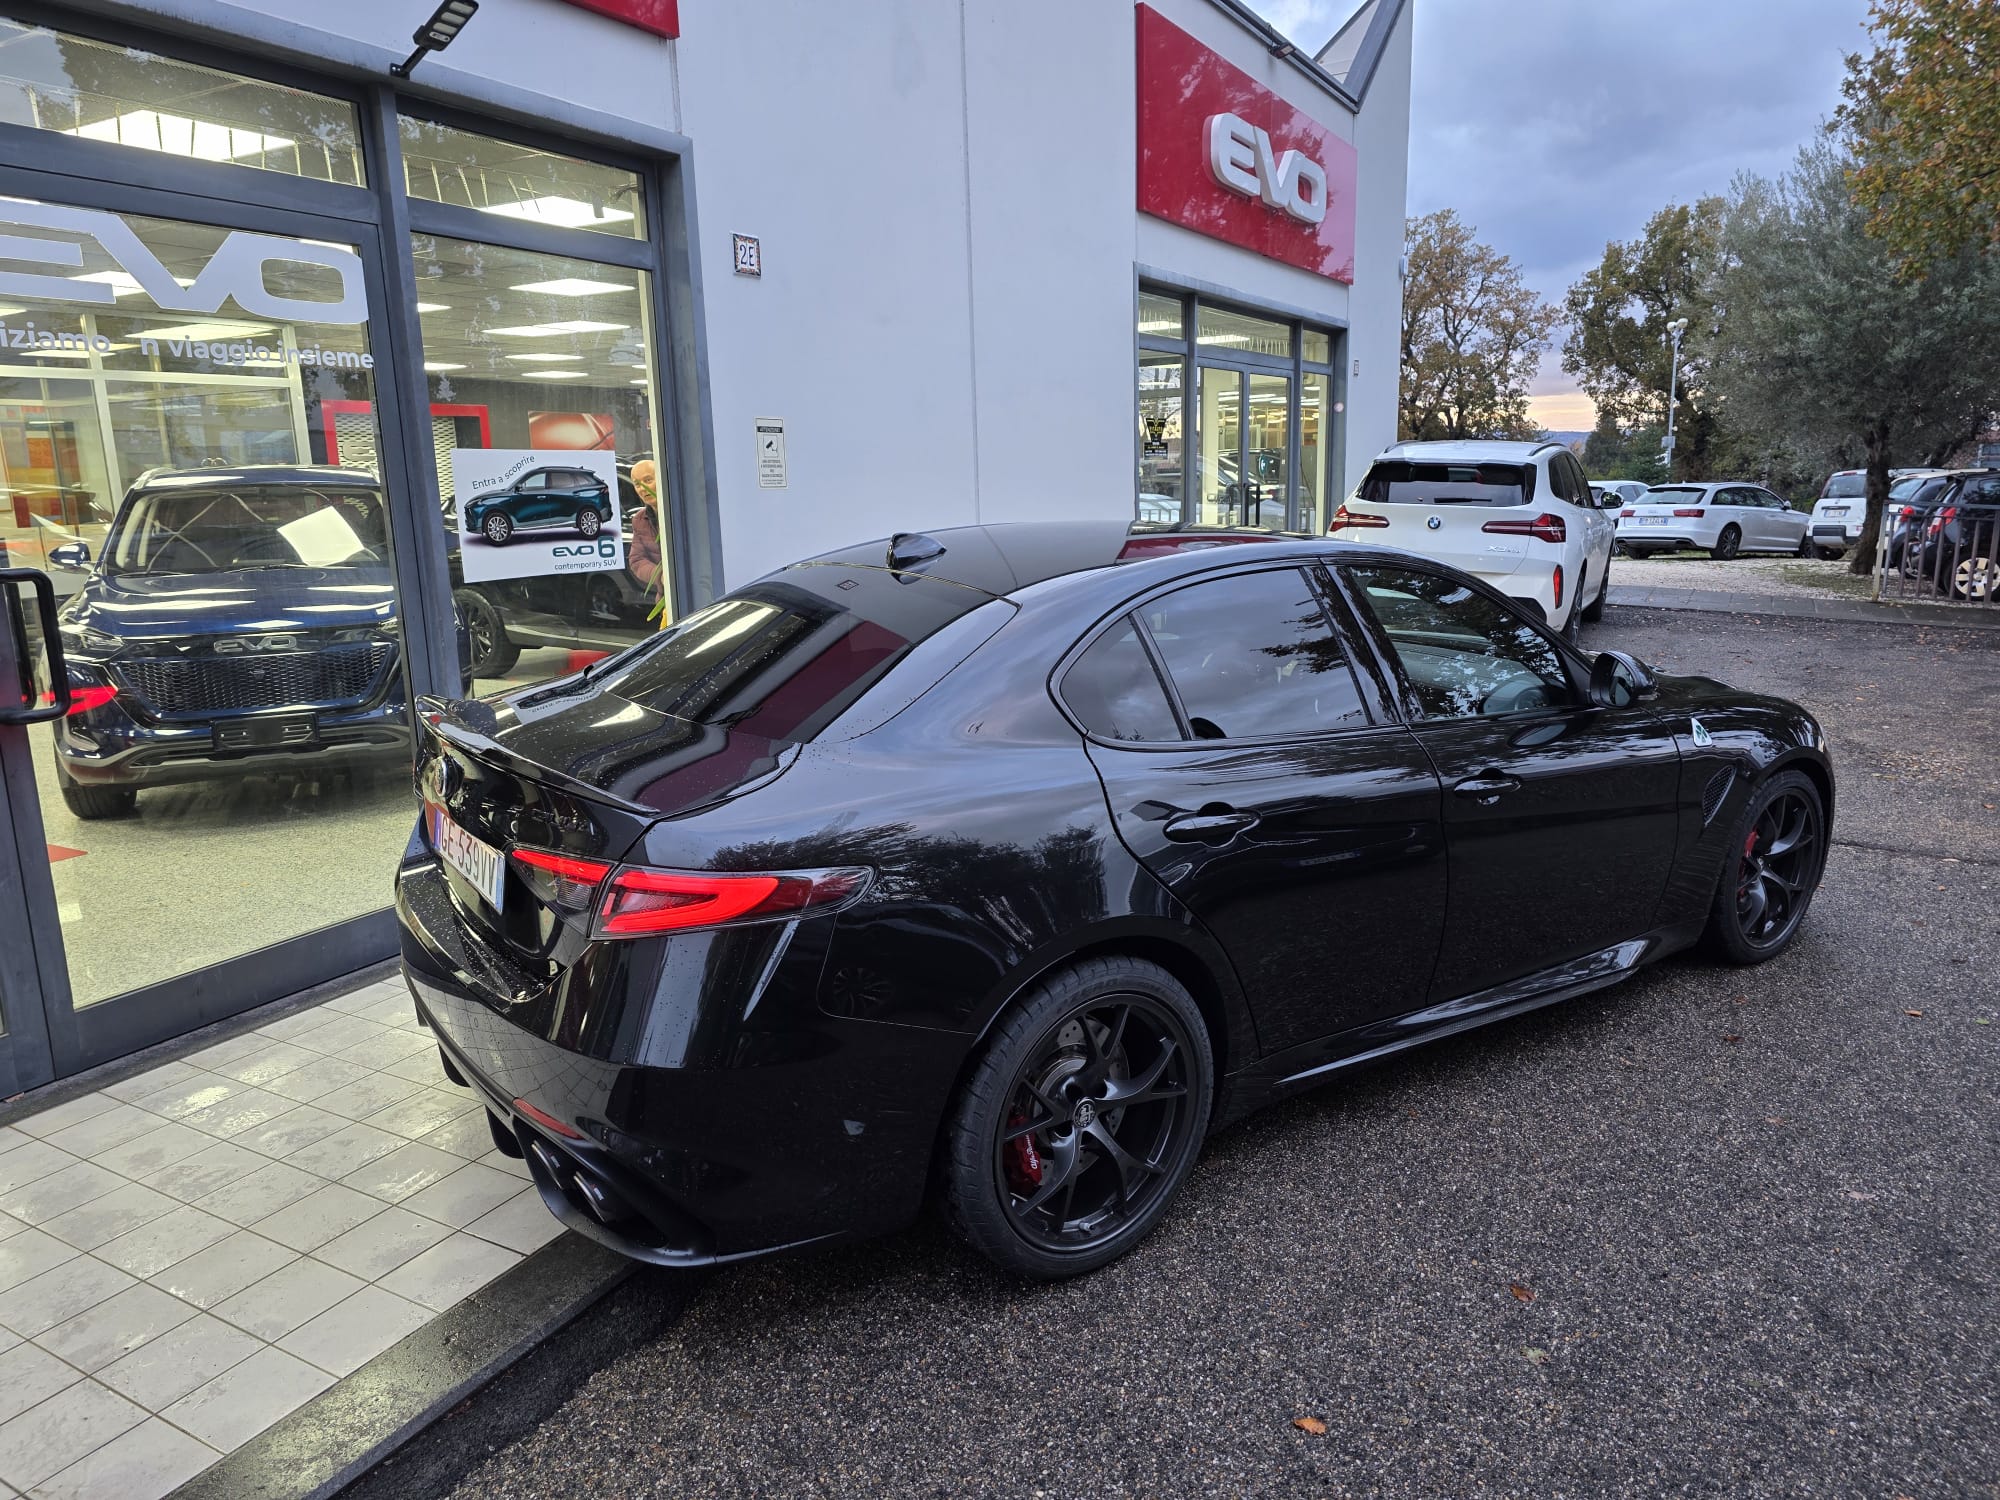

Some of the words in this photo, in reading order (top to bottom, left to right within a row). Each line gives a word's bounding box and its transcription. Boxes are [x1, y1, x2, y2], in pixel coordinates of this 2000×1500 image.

[1207, 112, 1328, 224] EVO
[0, 199, 369, 325] EVO
[739, 244, 755, 267] 2E
[167, 334, 271, 365] viaggio
[277, 340, 374, 369] insieme
[472, 478, 497, 490] Entra
[504, 455, 535, 480] scoprire
[552, 545, 595, 557] EVO
[597, 535, 616, 558] 6
[554, 561, 602, 570] contemporary
[603, 559, 617, 567] SUV
[213, 635, 297, 653] EVO
[441, 814, 456, 859] GE
